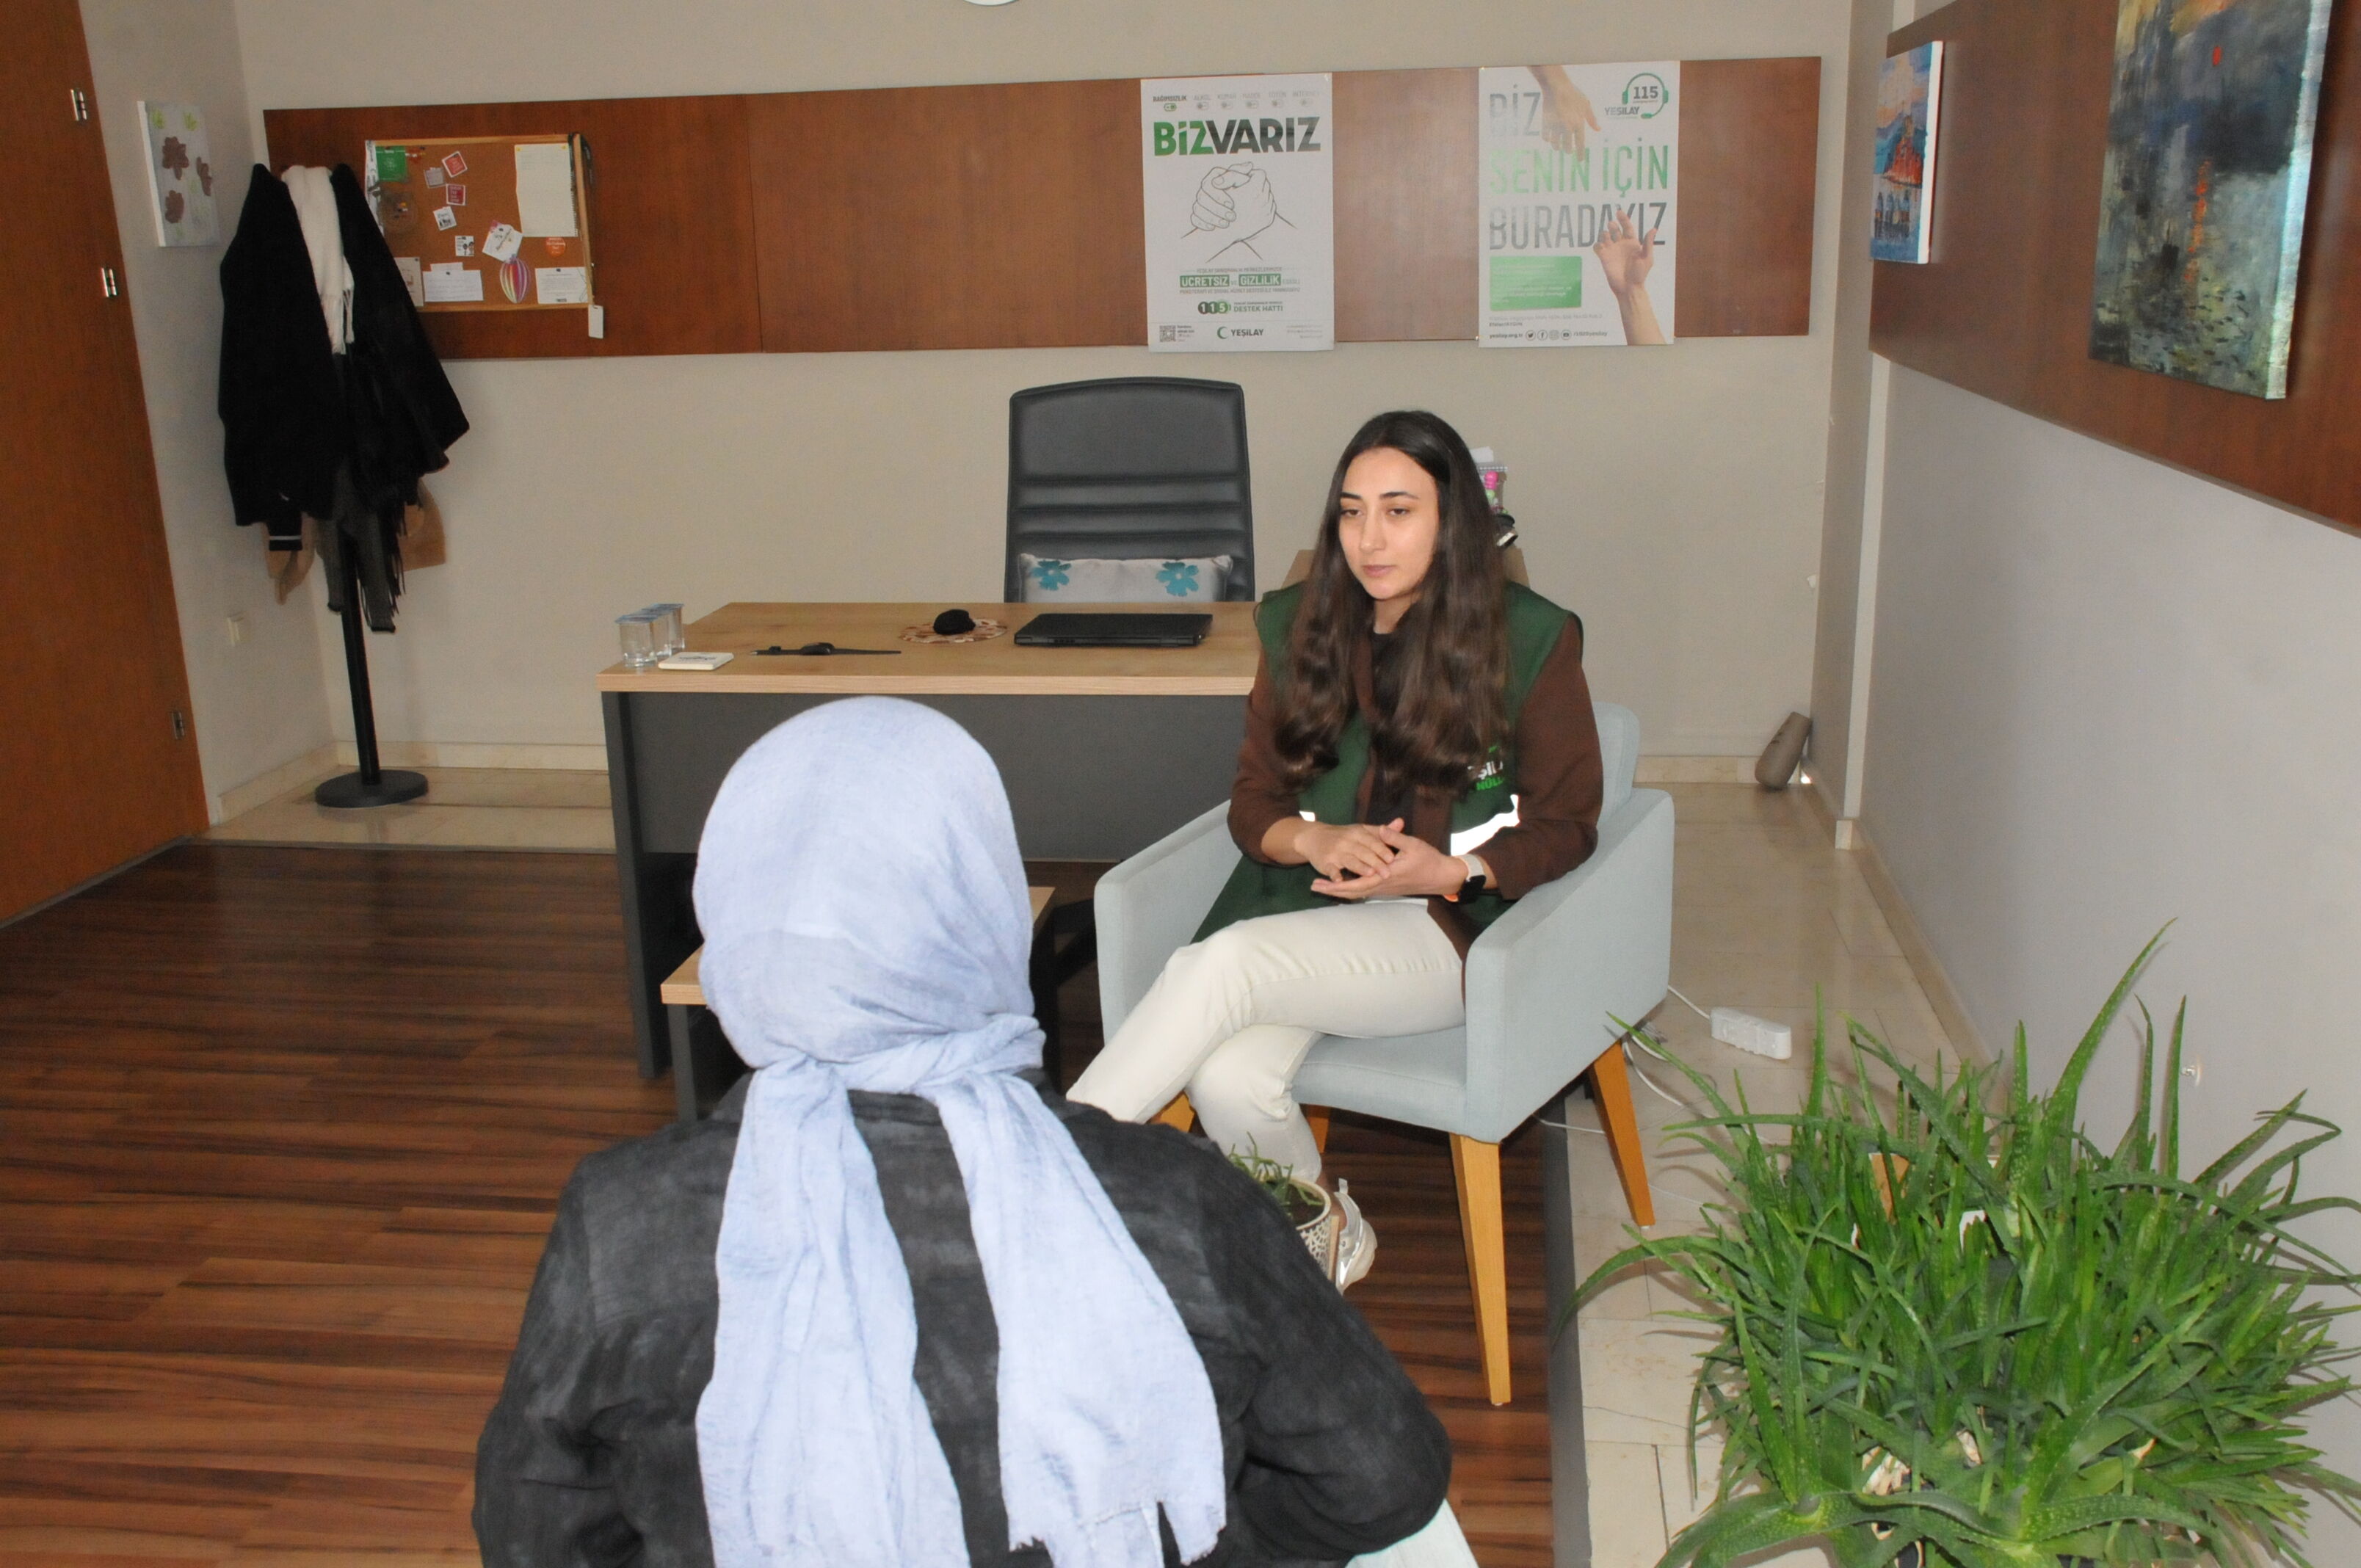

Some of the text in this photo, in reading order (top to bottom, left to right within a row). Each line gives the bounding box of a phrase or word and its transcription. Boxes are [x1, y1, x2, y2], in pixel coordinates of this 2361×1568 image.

[1633, 86, 1658, 99] 115
[1603, 137, 1668, 197] İÇİN
[1490, 202, 1667, 250] BURADAYIZ
[1200, 302, 1227, 313] 115
[1231, 329, 1263, 338] YEŞİLAY
